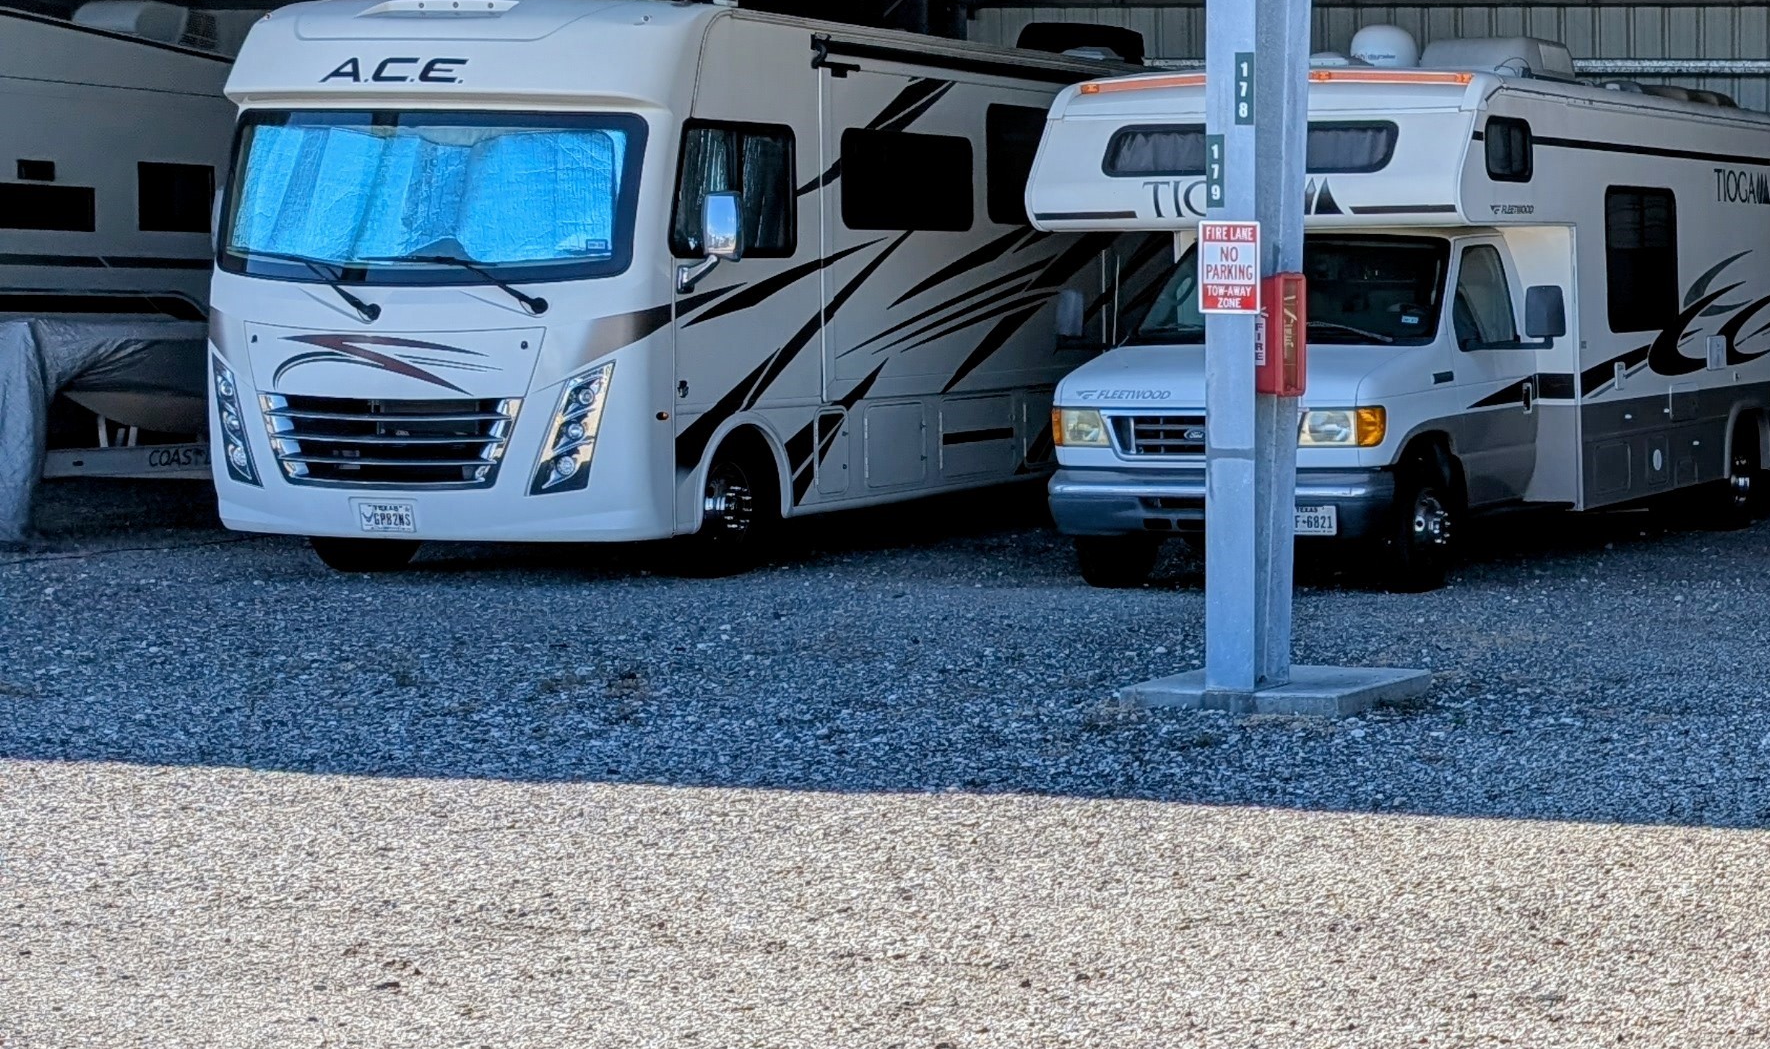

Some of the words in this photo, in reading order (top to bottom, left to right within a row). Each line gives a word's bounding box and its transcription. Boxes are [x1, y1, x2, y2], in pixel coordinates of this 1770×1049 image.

[318, 57, 469, 83] A.C.E.
[1238, 61, 1248, 118] 178
[1211, 144, 1221, 200] 179
[1714, 168, 1757, 204] TIOGA
[1206, 226, 1228, 240] FIRE
[1230, 227, 1254, 241] LANE
[1220, 246, 1239, 262] NO
[1206, 264, 1253, 281] PARKING
[1206, 285, 1252, 297] TOW-AWAY
[1217, 297, 1241, 308] ZONE
[1255, 322, 1264, 361] FIRE
[1097, 389, 1172, 400] FLEETWOOD
